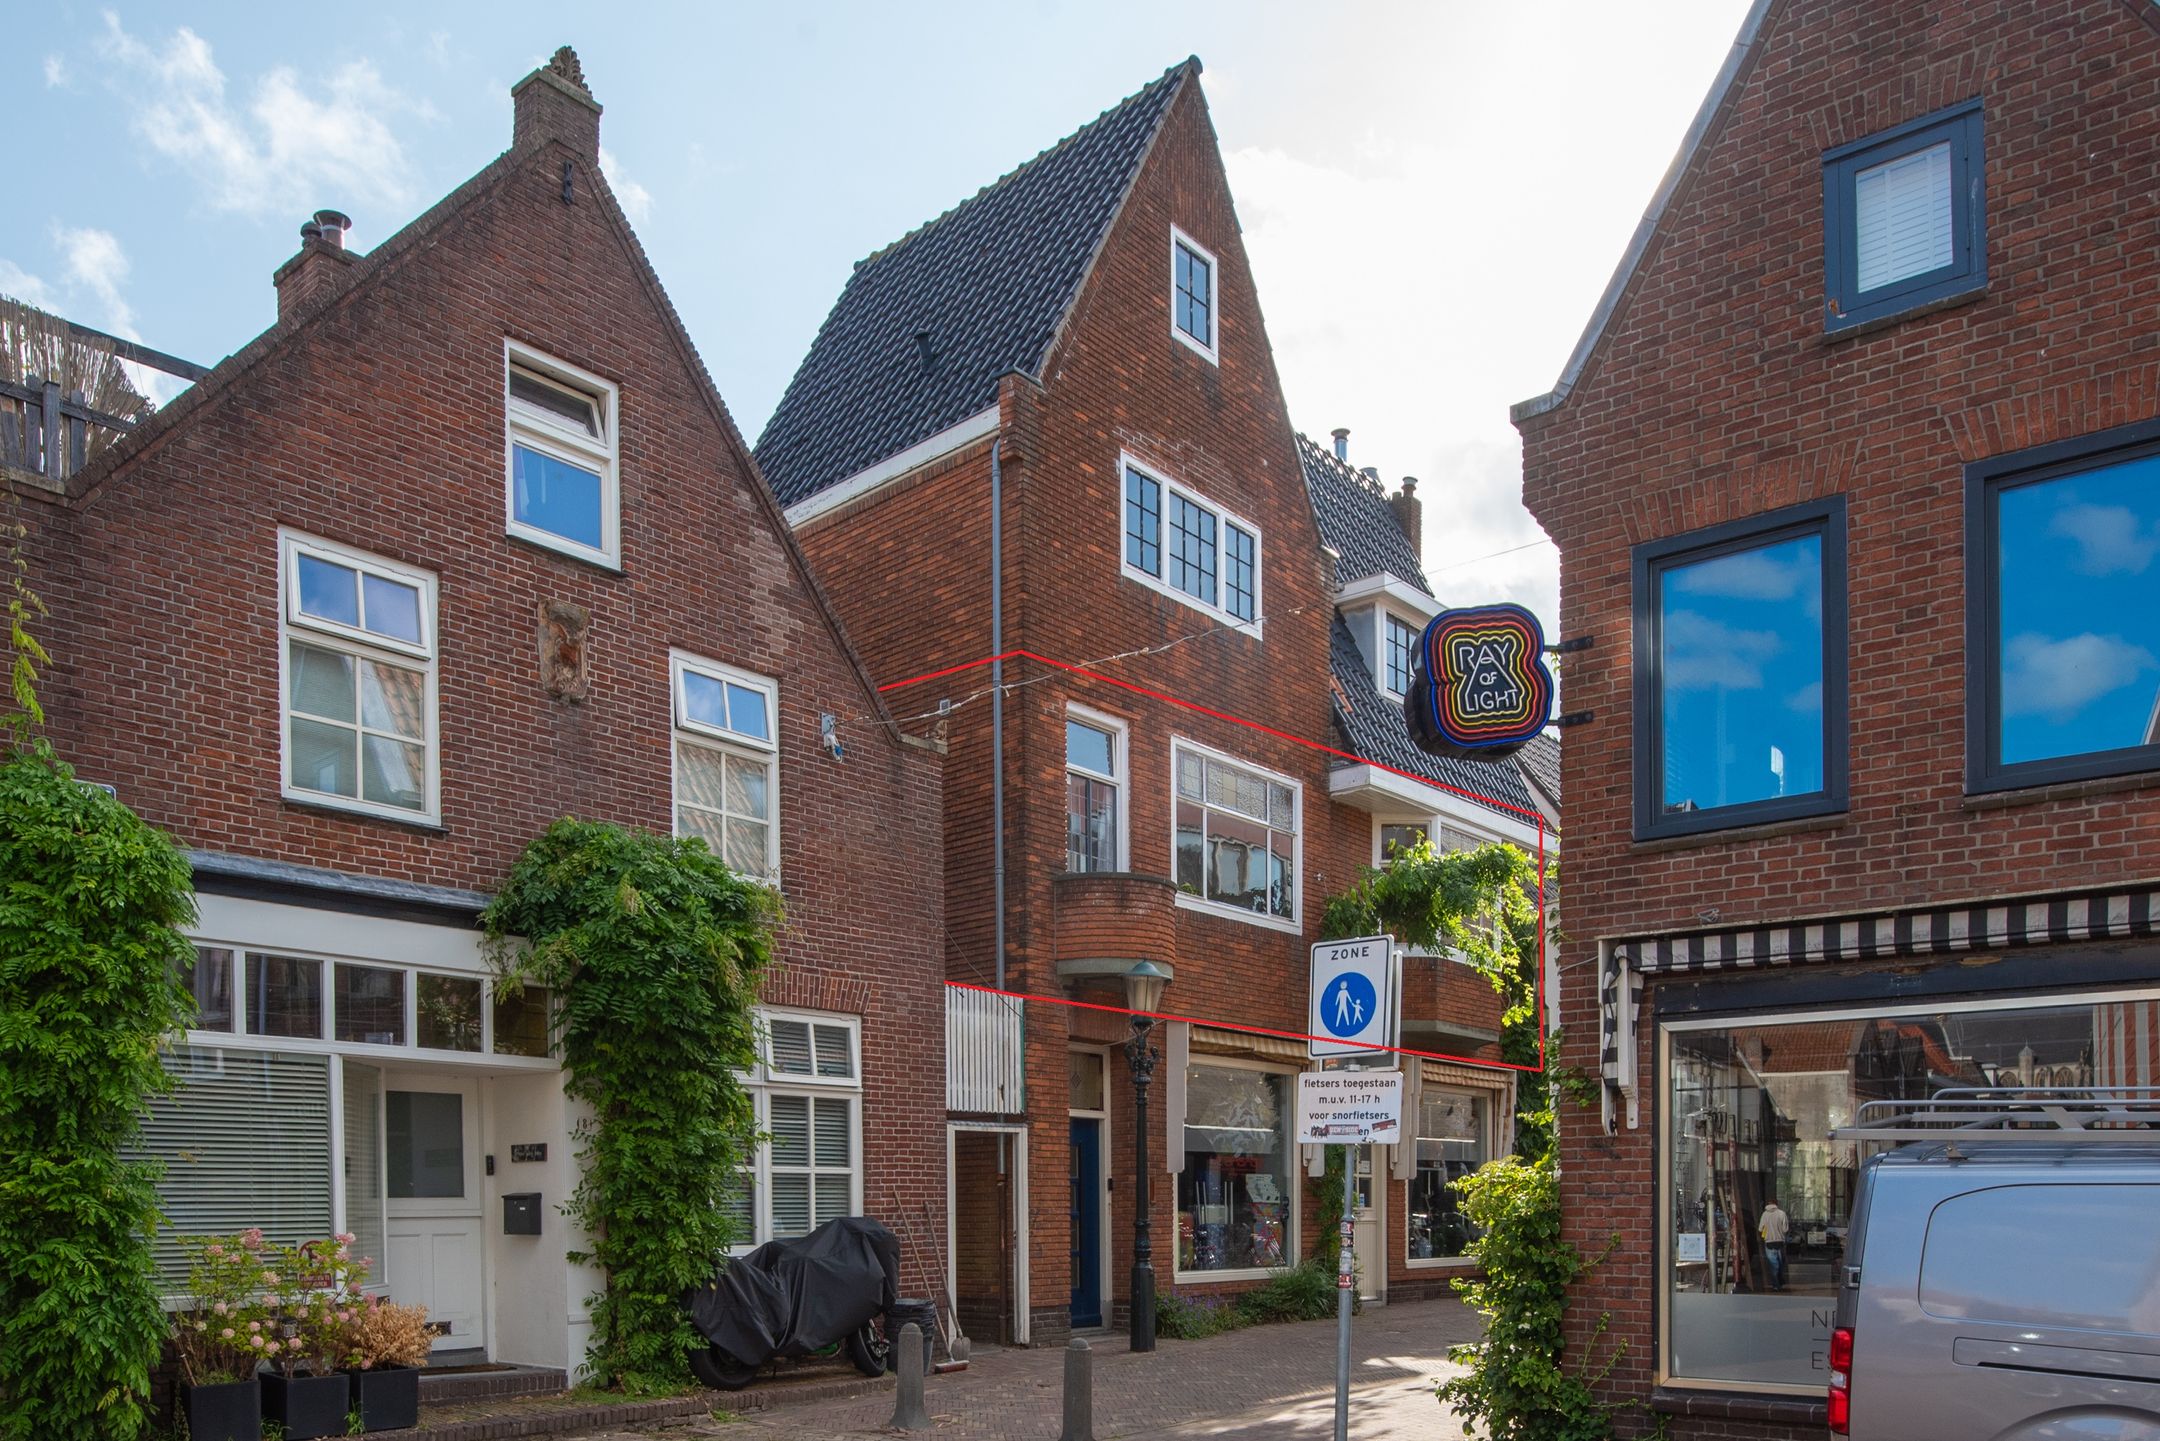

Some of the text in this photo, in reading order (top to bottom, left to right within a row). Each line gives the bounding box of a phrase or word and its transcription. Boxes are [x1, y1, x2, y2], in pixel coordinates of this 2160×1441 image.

[1459, 642, 1510, 671] RAY
[1479, 672, 1498, 685] OF
[1464, 689, 1518, 711] LIGHT
[1330, 946, 1370, 961] ZONE
[1304, 1079, 1397, 1090] fietsers toegestaan
[1318, 1094, 1381, 1104] m.u.v. 11-17 h
[1309, 1110, 1390, 1120] voor snorfietsers
